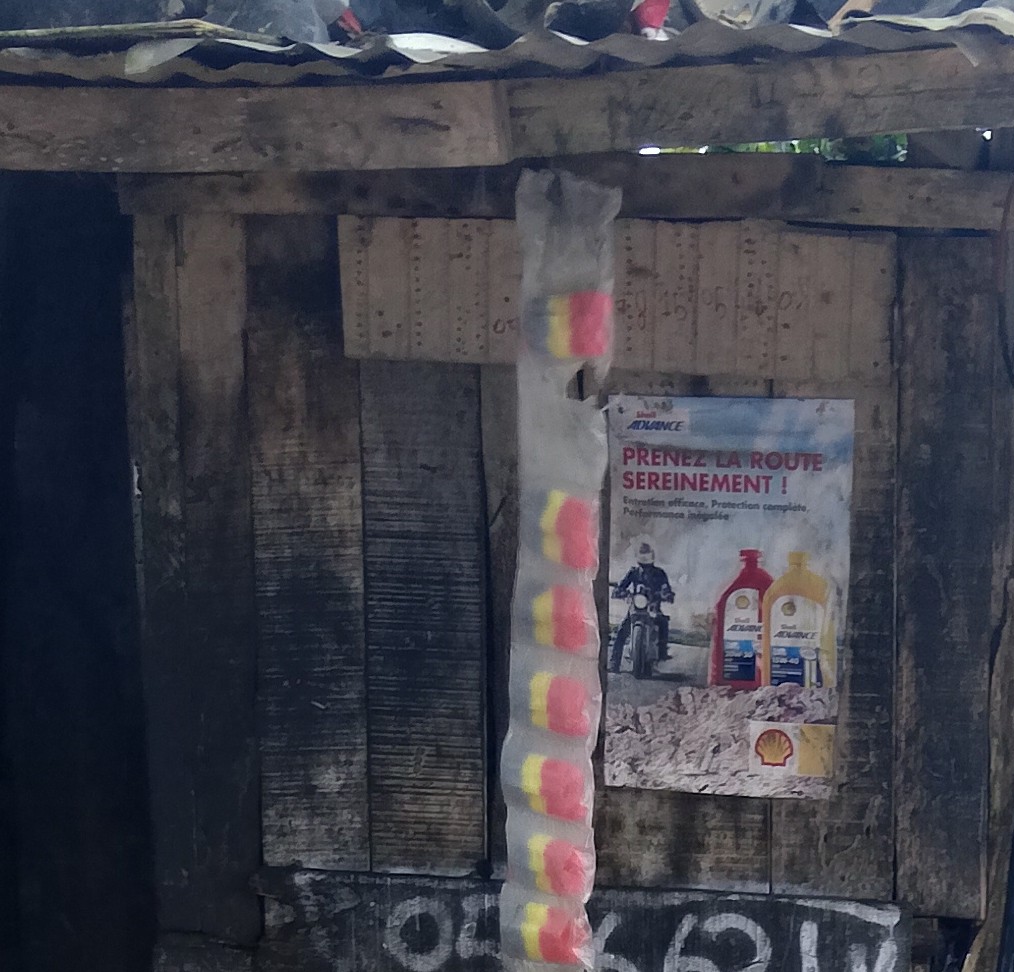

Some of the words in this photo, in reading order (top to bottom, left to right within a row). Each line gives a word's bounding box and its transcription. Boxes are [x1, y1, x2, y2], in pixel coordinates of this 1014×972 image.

[627, 420, 684, 431] ADVANCE
[622, 447, 707, 467] PRENEZ
[715, 450, 742, 469] LA
[750, 452, 823, 472] ROUTE
[622, 471, 773, 494] SEREINEMENT
